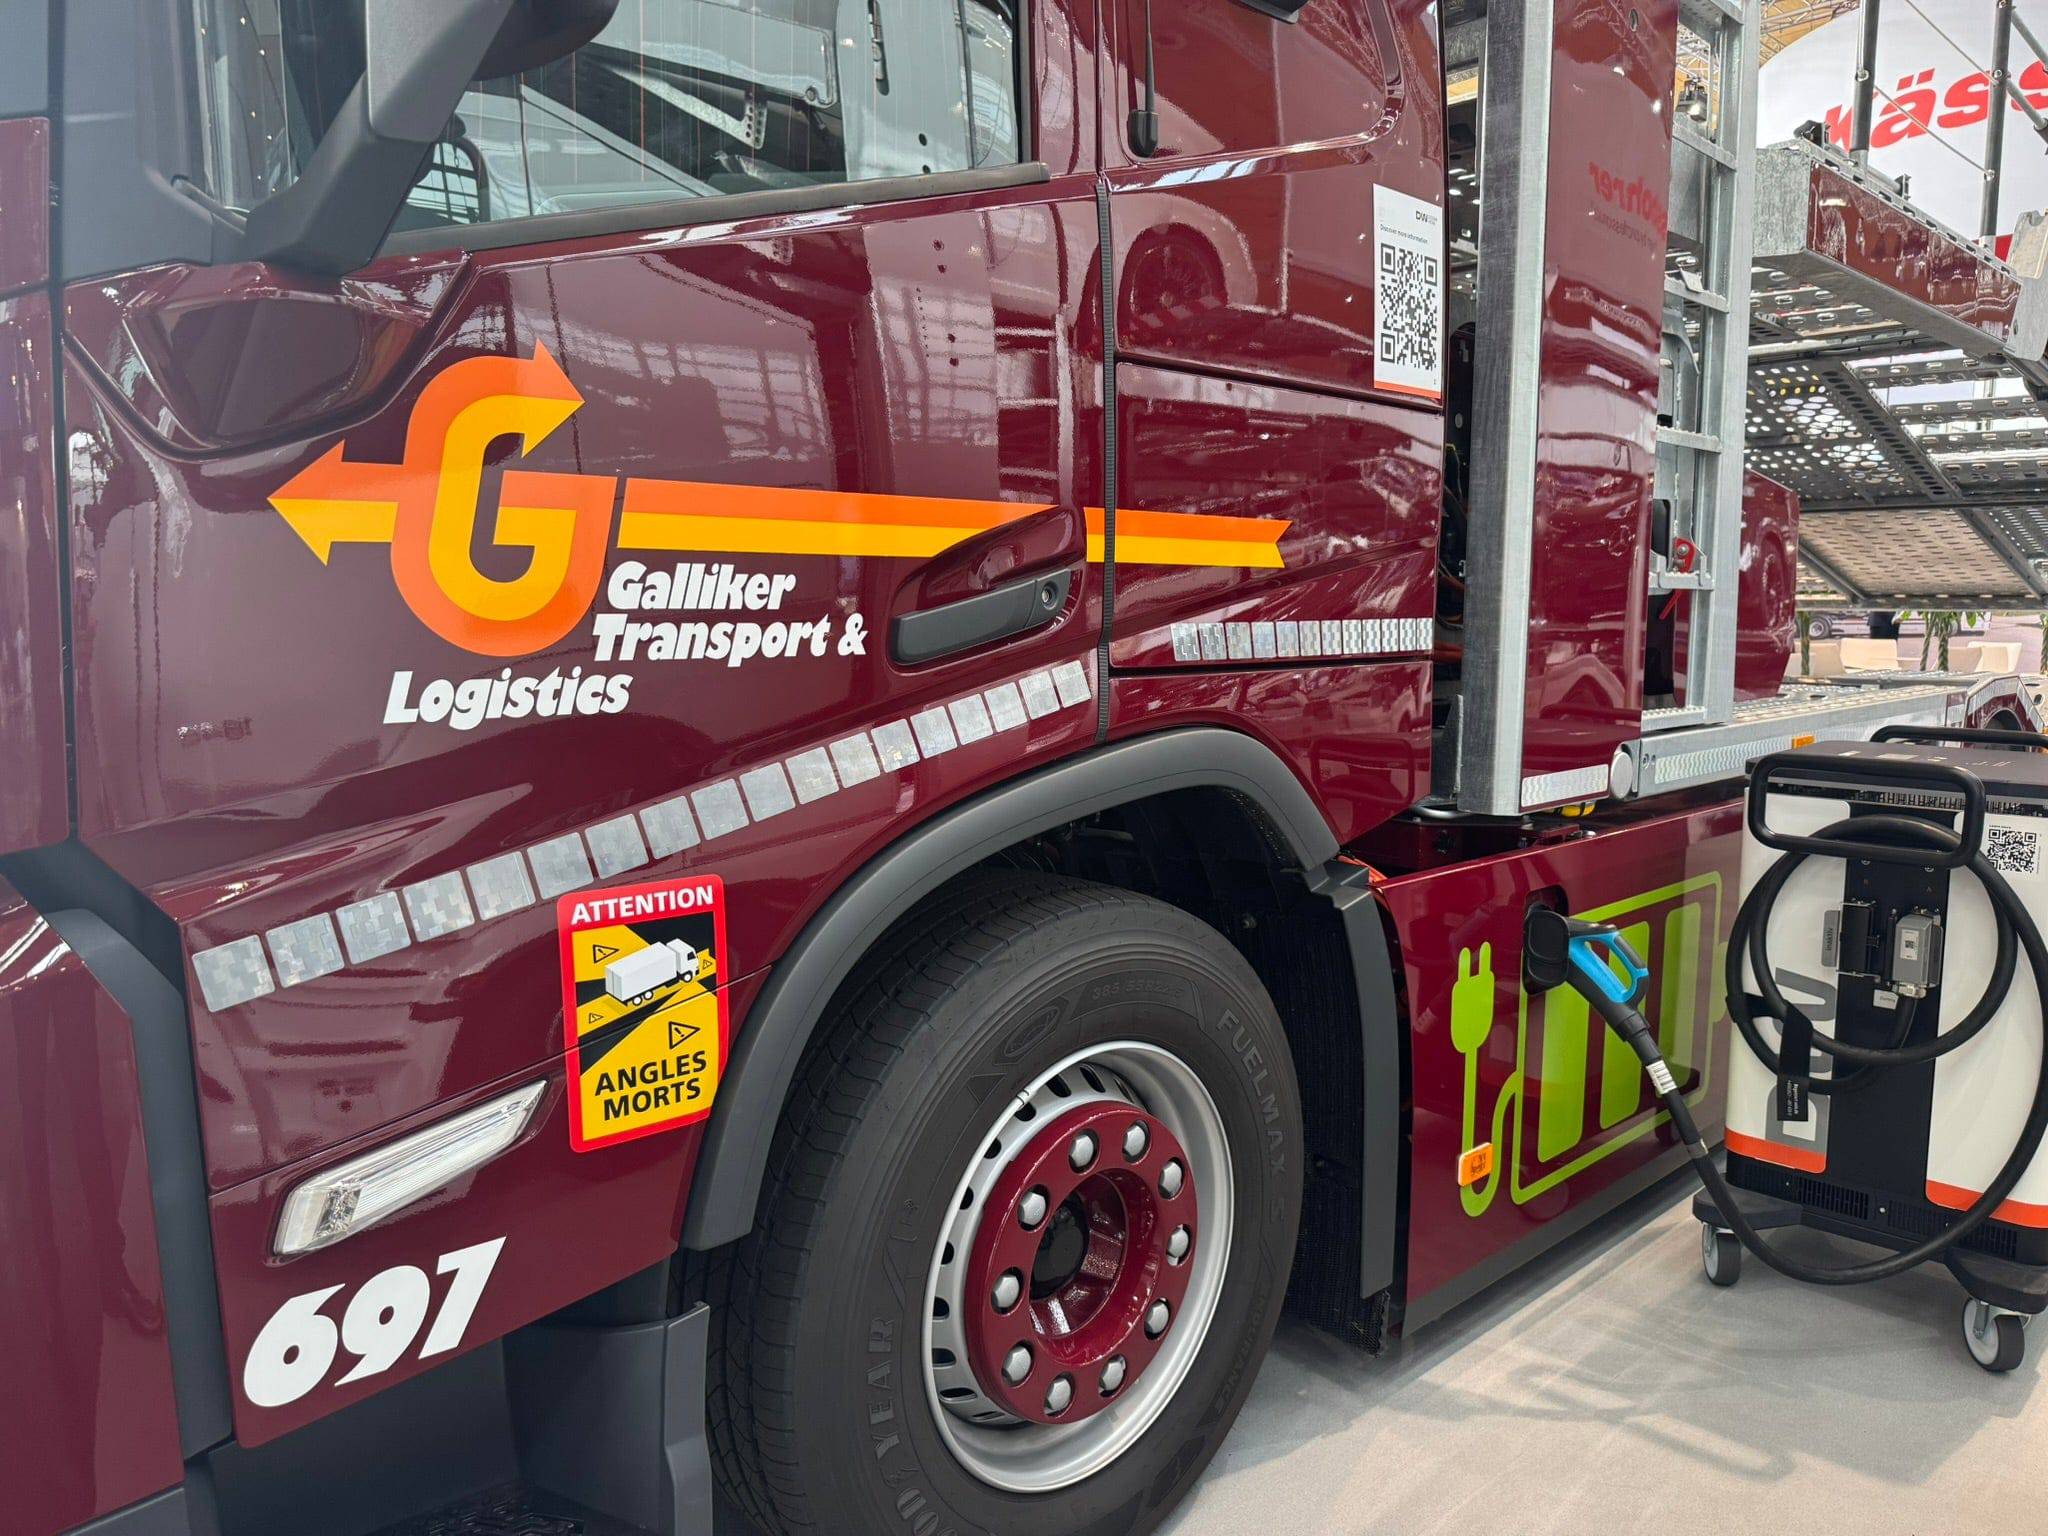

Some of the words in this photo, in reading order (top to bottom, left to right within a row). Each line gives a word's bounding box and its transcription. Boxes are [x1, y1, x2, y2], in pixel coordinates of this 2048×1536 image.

[606, 560, 797, 611] Galliker
[592, 613, 831, 668] Transport
[837, 612, 868, 656] &
[382, 666, 635, 730] Logistics
[571, 884, 714, 925] ATTENTION
[594, 1050, 708, 1096] ANGLES
[603, 1077, 701, 1121] MORTS
[1215, 1008, 1287, 1178] FUELMAX
[243, 1235, 507, 1408] 697
[866, 1315, 900, 1462] YEAR
